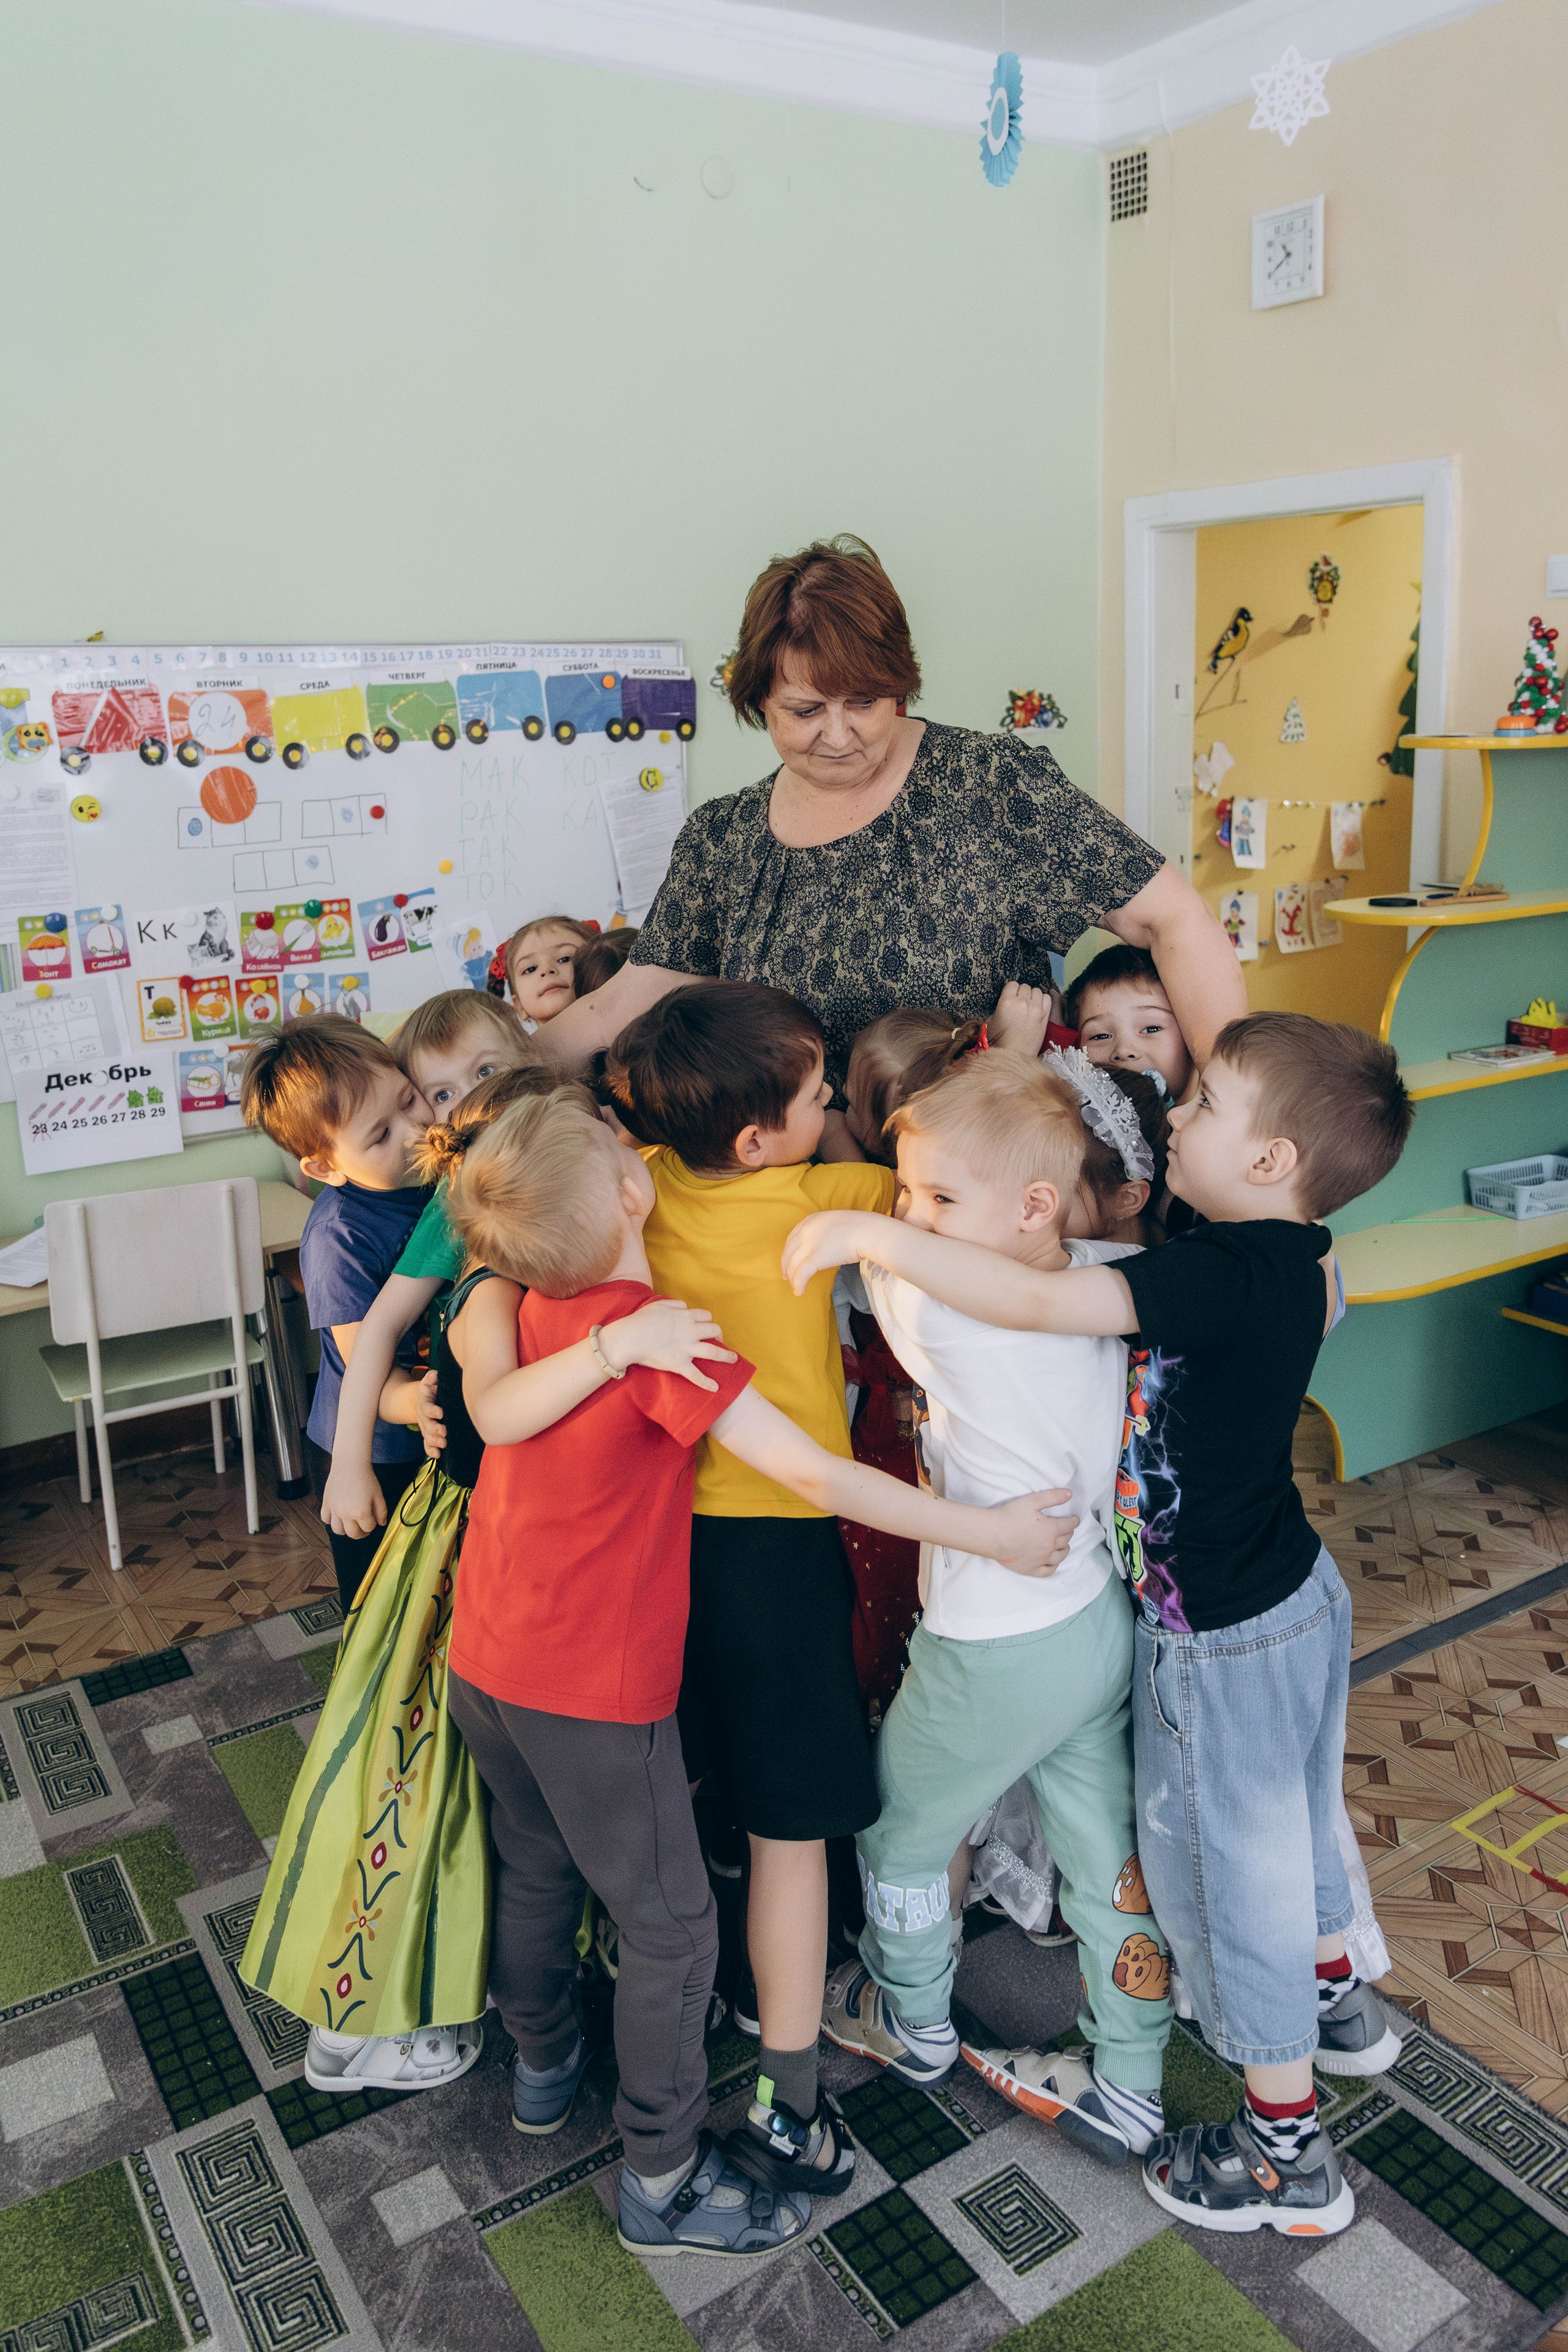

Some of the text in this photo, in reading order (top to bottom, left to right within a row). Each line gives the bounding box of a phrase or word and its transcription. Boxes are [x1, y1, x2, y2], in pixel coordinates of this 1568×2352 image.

[61, 646, 662, 668] 1 2 3 4 5 6 7 8 9 10 11 12 13 14 15 16 17 18 19 20 21 22 23 24 25 26 27 28 29 30 31
[476, 661, 518, 671] ПЯТНИЦА
[563, 662, 599, 672] СУББОТА
[197, 680, 243, 689] ВТОРНИК
[300, 680, 331, 690] СРЕДА
[388, 671, 426, 680] ЧЕТВЕРГ
[196, 703, 236, 738] 24
[459, 754, 530, 796] МАК
[460, 798, 523, 835] РАК
[458, 834, 518, 872] ТАК
[459, 865, 522, 901] ТОК
[45, 1064, 152, 1093] Декбрь
[32, 1107, 165, 1134] 23 24 25 26 27 28 29
